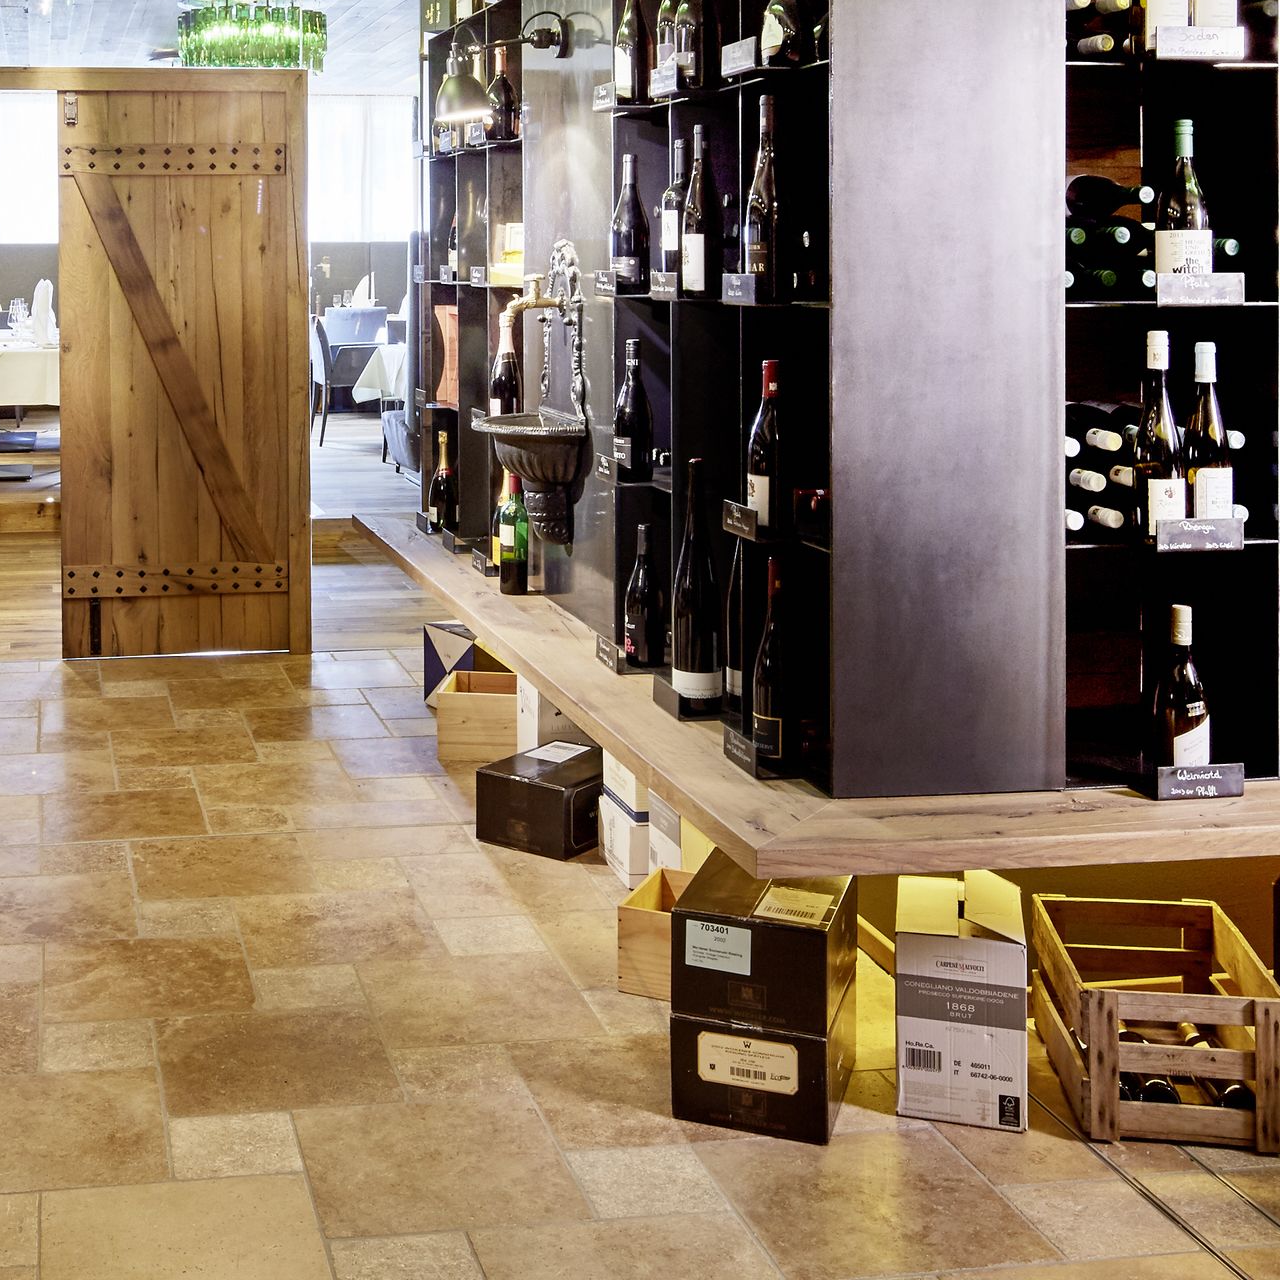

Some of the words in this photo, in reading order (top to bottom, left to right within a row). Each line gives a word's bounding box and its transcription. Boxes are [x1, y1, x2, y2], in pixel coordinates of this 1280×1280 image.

[1185, 257, 1199, 265] the
[700, 923, 729, 935] 703401
[904, 980, 953, 992] CONEGLIANO
[955, 985, 1019, 1000] VALDOBBIADENE
[946, 1001, 975, 1013] 1868
